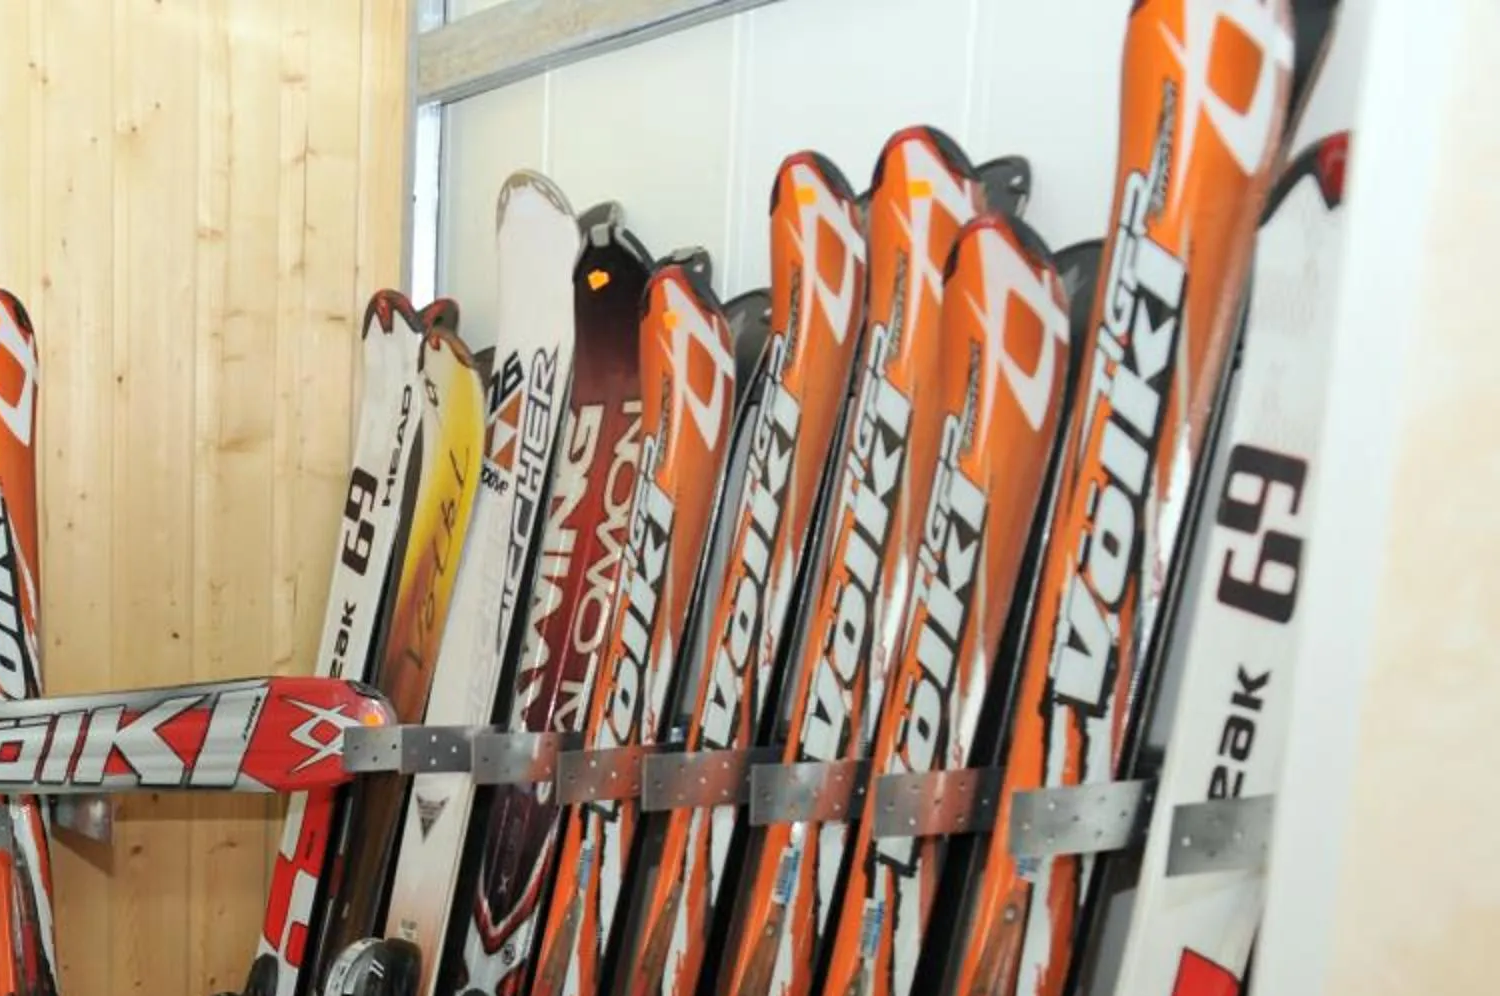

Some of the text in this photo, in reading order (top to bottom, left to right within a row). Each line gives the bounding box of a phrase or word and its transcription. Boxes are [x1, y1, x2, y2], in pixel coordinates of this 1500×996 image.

[342, 467, 379, 577] 69
[382, 384, 412, 507] HEAD
[1056, 235, 1188, 718] Völkl
[703, 380, 802, 750] Völkl
[803, 380, 913, 762] Völkl
[1216, 442, 1309, 626] 69
[329, 601, 357, 680] eak
[1208, 664, 1270, 800] eak
